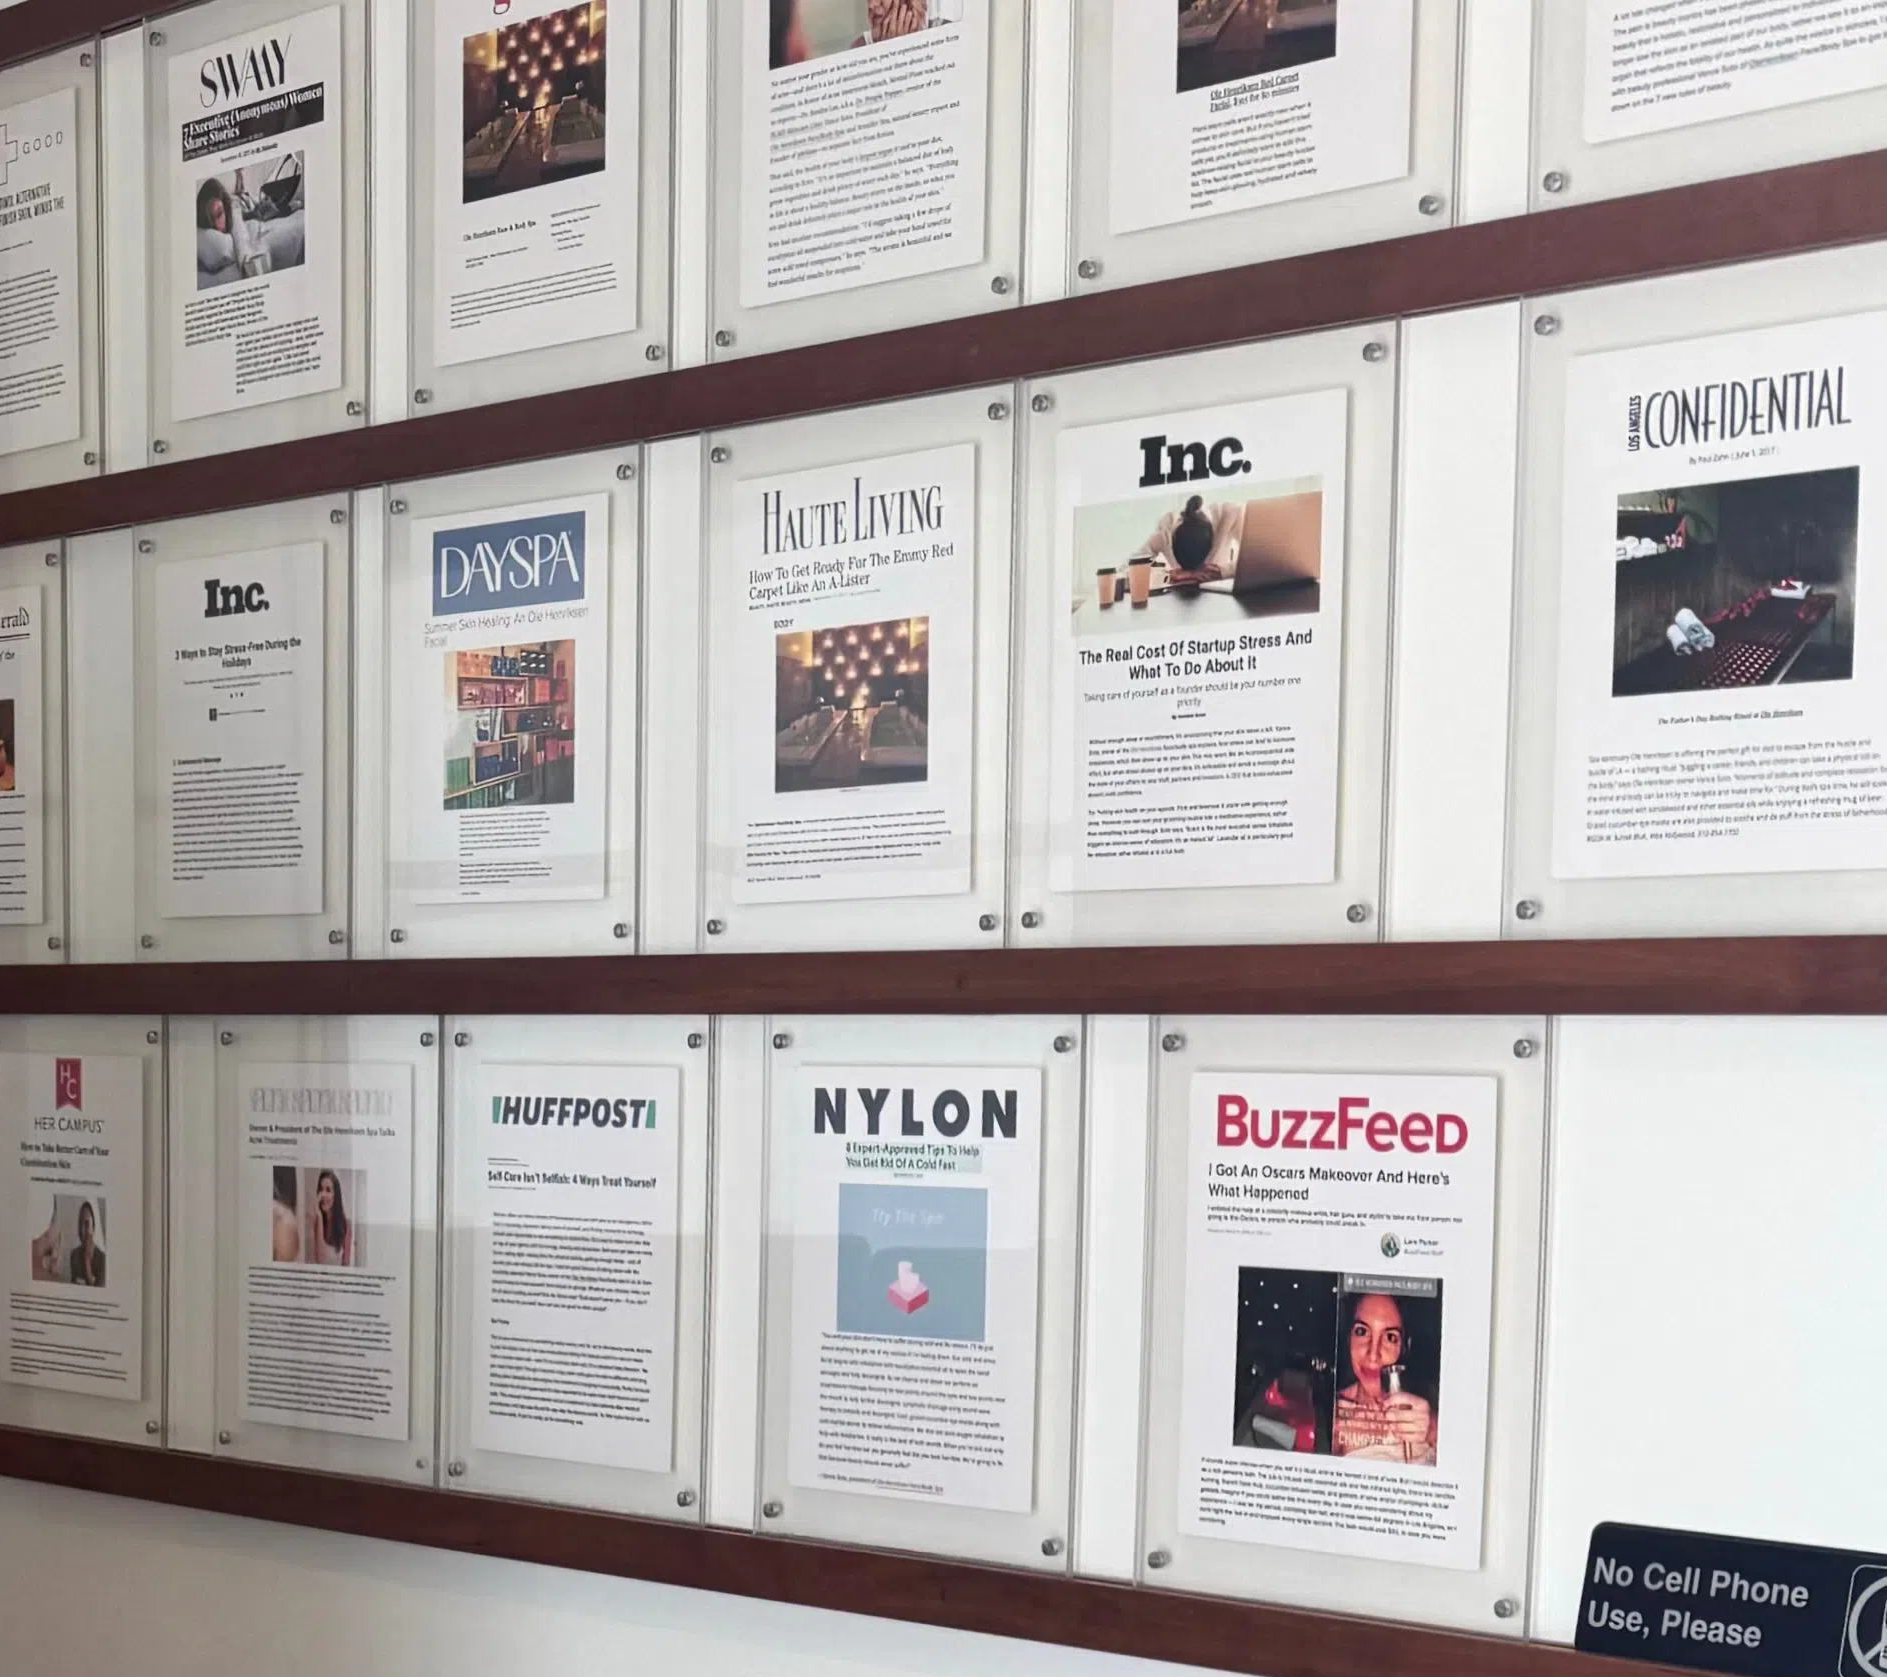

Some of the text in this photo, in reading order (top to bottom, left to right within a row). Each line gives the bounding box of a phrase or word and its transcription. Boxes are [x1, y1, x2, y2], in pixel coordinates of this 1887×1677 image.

[23, 131, 63, 154] GOOD
[1644, 366, 1852, 448] CONFIDENTIAL
[1139, 434, 1252, 488] Inc.
[441, 531, 579, 598] DAYSPA
[750, 570, 773, 584] How
[775, 567, 789, 580] To
[792, 564, 809, 577] Get
[814, 559, 845, 575] Ready
[849, 556, 867, 570] For
[869, 553, 890, 567] The
[932, 542, 953, 558] Red
[204, 579, 270, 618] Inc.
[749, 585, 783, 600] Carpet
[787, 581, 808, 595] Like
[812, 580, 825, 592] An
[1079, 628, 1312, 665] The Real Cost Of Startup Stress And
[1129, 664, 1161, 680] What
[1165, 663, 1180, 677] To
[1184, 661, 1201, 675] Do
[1205, 657, 1243, 674] About
[502, 1096, 647, 1128] HUFFPOST
[814, 1087, 1017, 1139] NYLON
[1208, 1183, 1309, 1202] What Happened
[1216, 1163, 1237, 1177] Got
[1241, 1164, 1258, 1177] An
[1262, 1165, 1305, 1180] Oscars
[1309, 1167, 1373, 1182] Makeover
[1376, 1169, 1403, 1183] And
[1407, 1171, 1450, 1185] Here's
[1593, 1556, 1809, 1608] No Cell Phone
[1587, 1600, 1762, 1648] Use, Please
